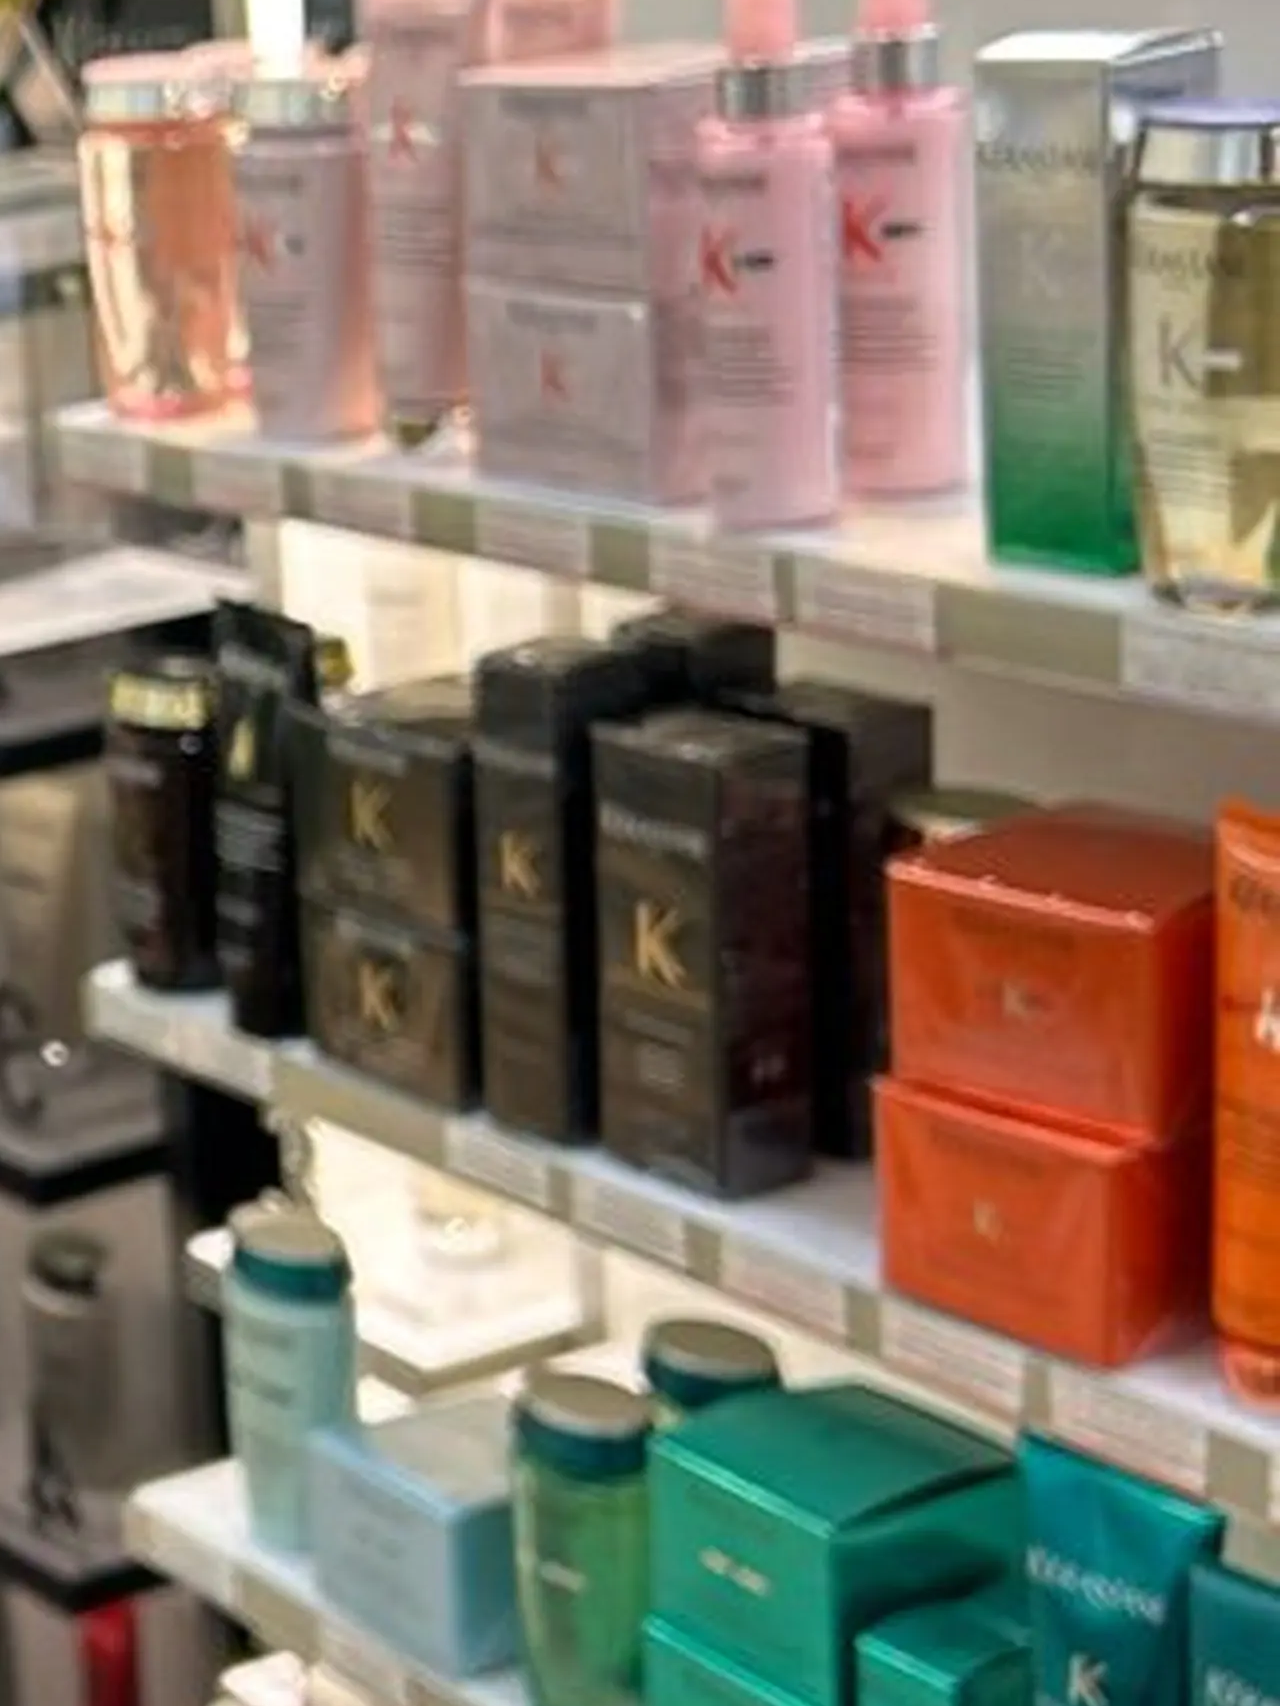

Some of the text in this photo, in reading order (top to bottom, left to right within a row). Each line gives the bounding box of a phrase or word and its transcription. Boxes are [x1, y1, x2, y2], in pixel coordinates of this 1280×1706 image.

[842, 196, 886, 263] K
[1158, 315, 1201, 387] K
[350, 780, 394, 849] K
[499, 830, 540, 897] K
[635, 900, 686, 990] K
[360, 961, 400, 1031] K
